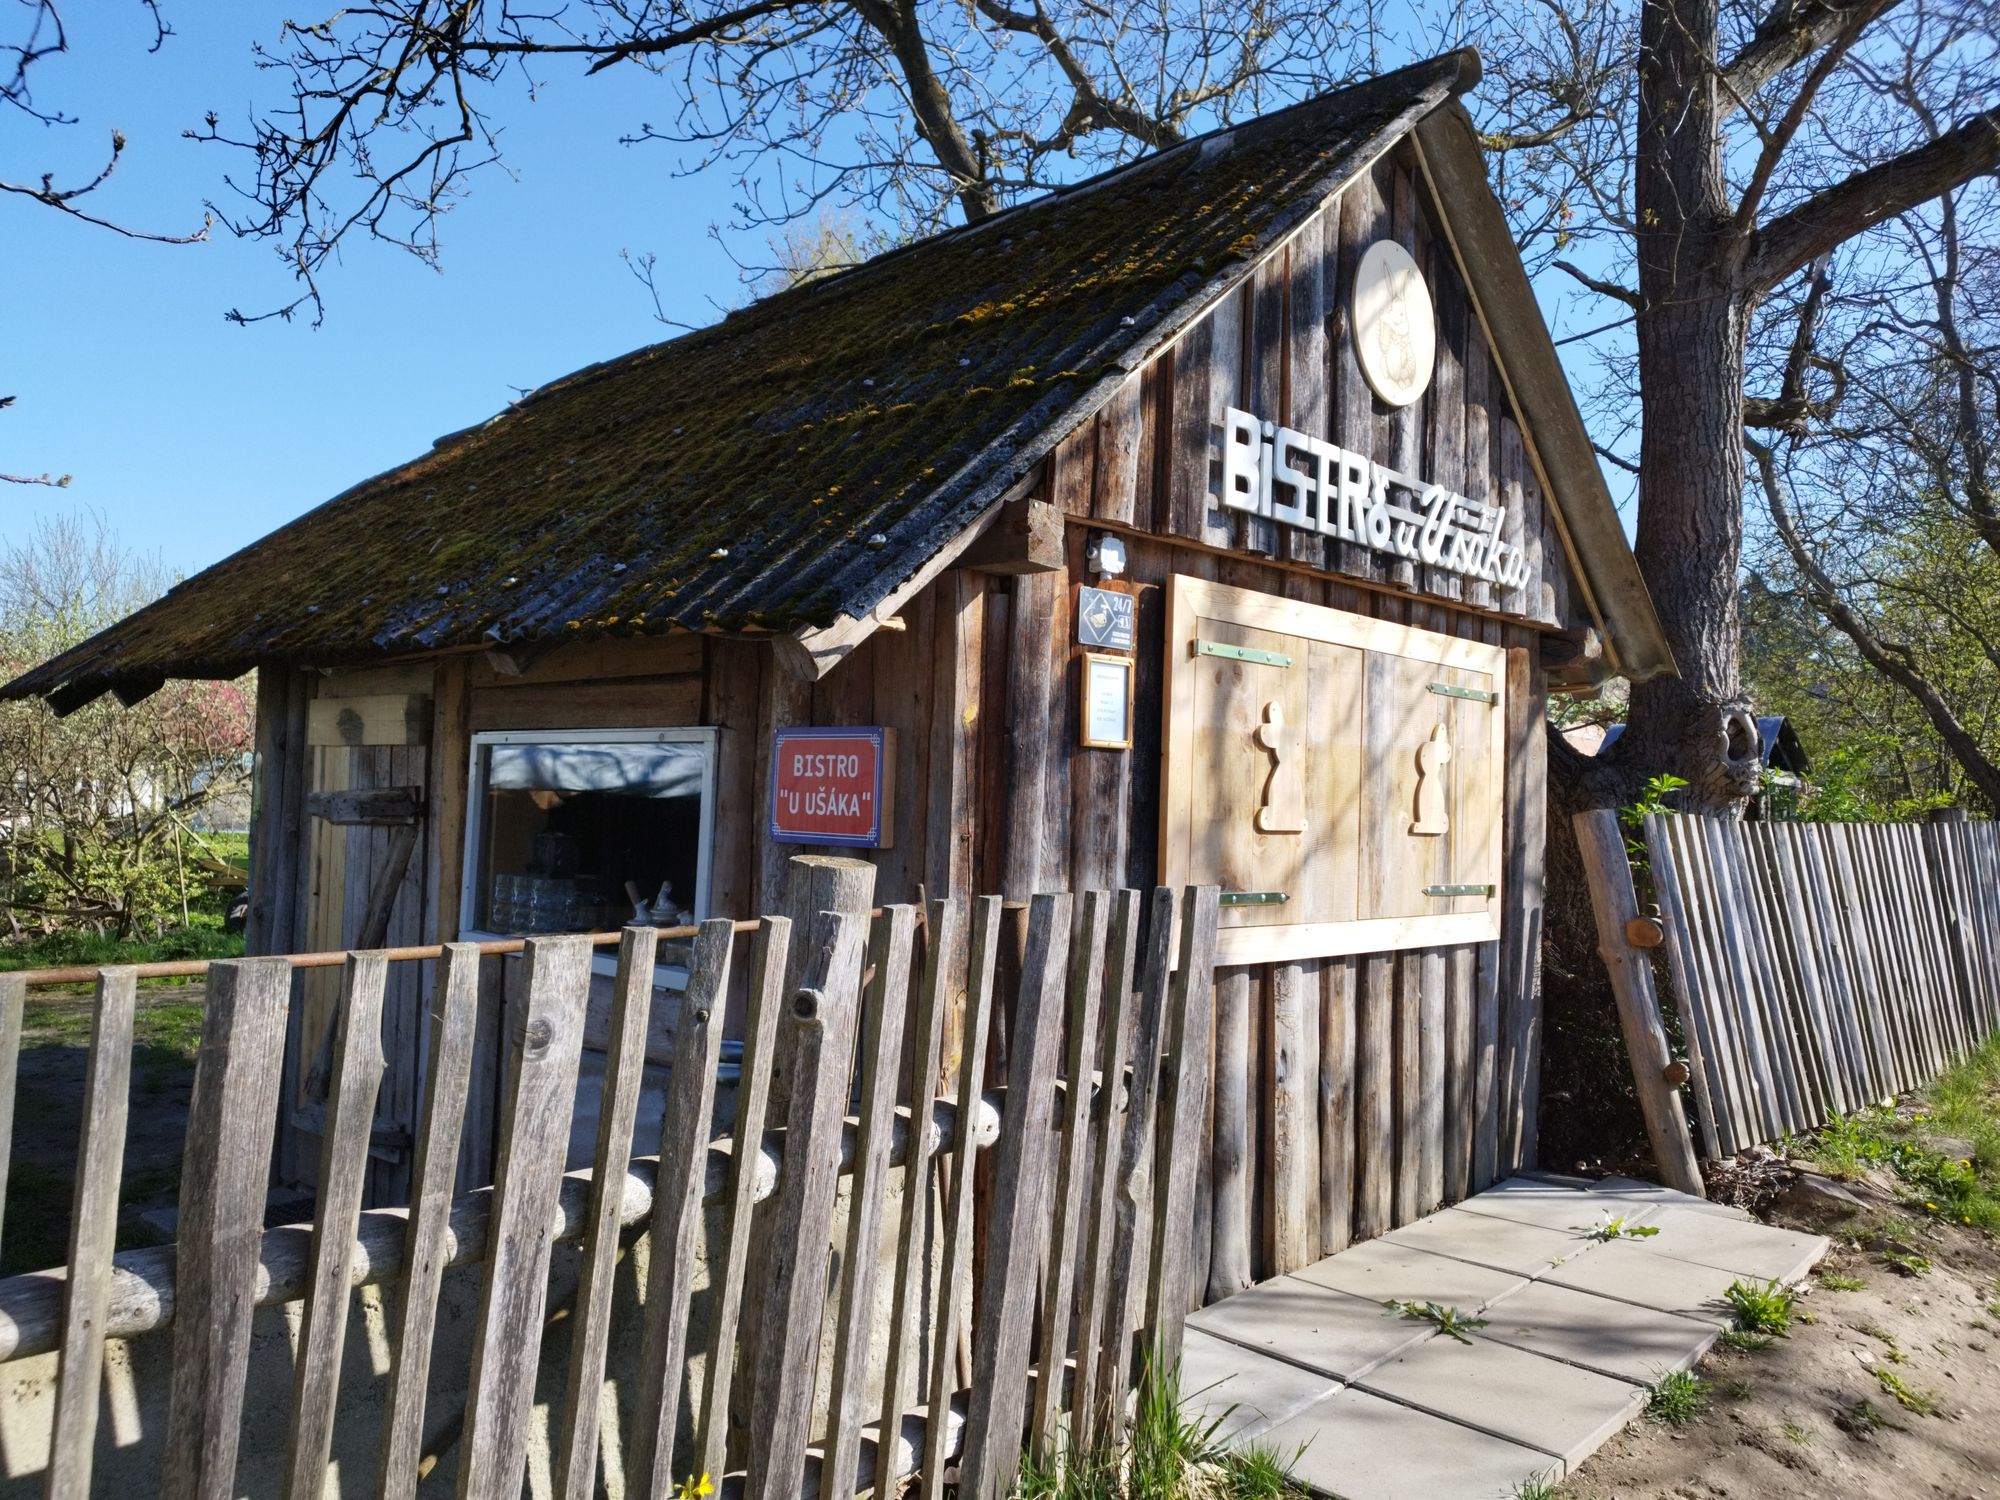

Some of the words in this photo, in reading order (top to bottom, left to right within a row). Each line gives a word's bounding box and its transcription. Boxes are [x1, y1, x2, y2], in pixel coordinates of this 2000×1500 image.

[1113, 596, 1132, 614] 24/7
[793, 754, 859, 778] BISTRO
[805, 786, 871, 817] UŠÁKA"
